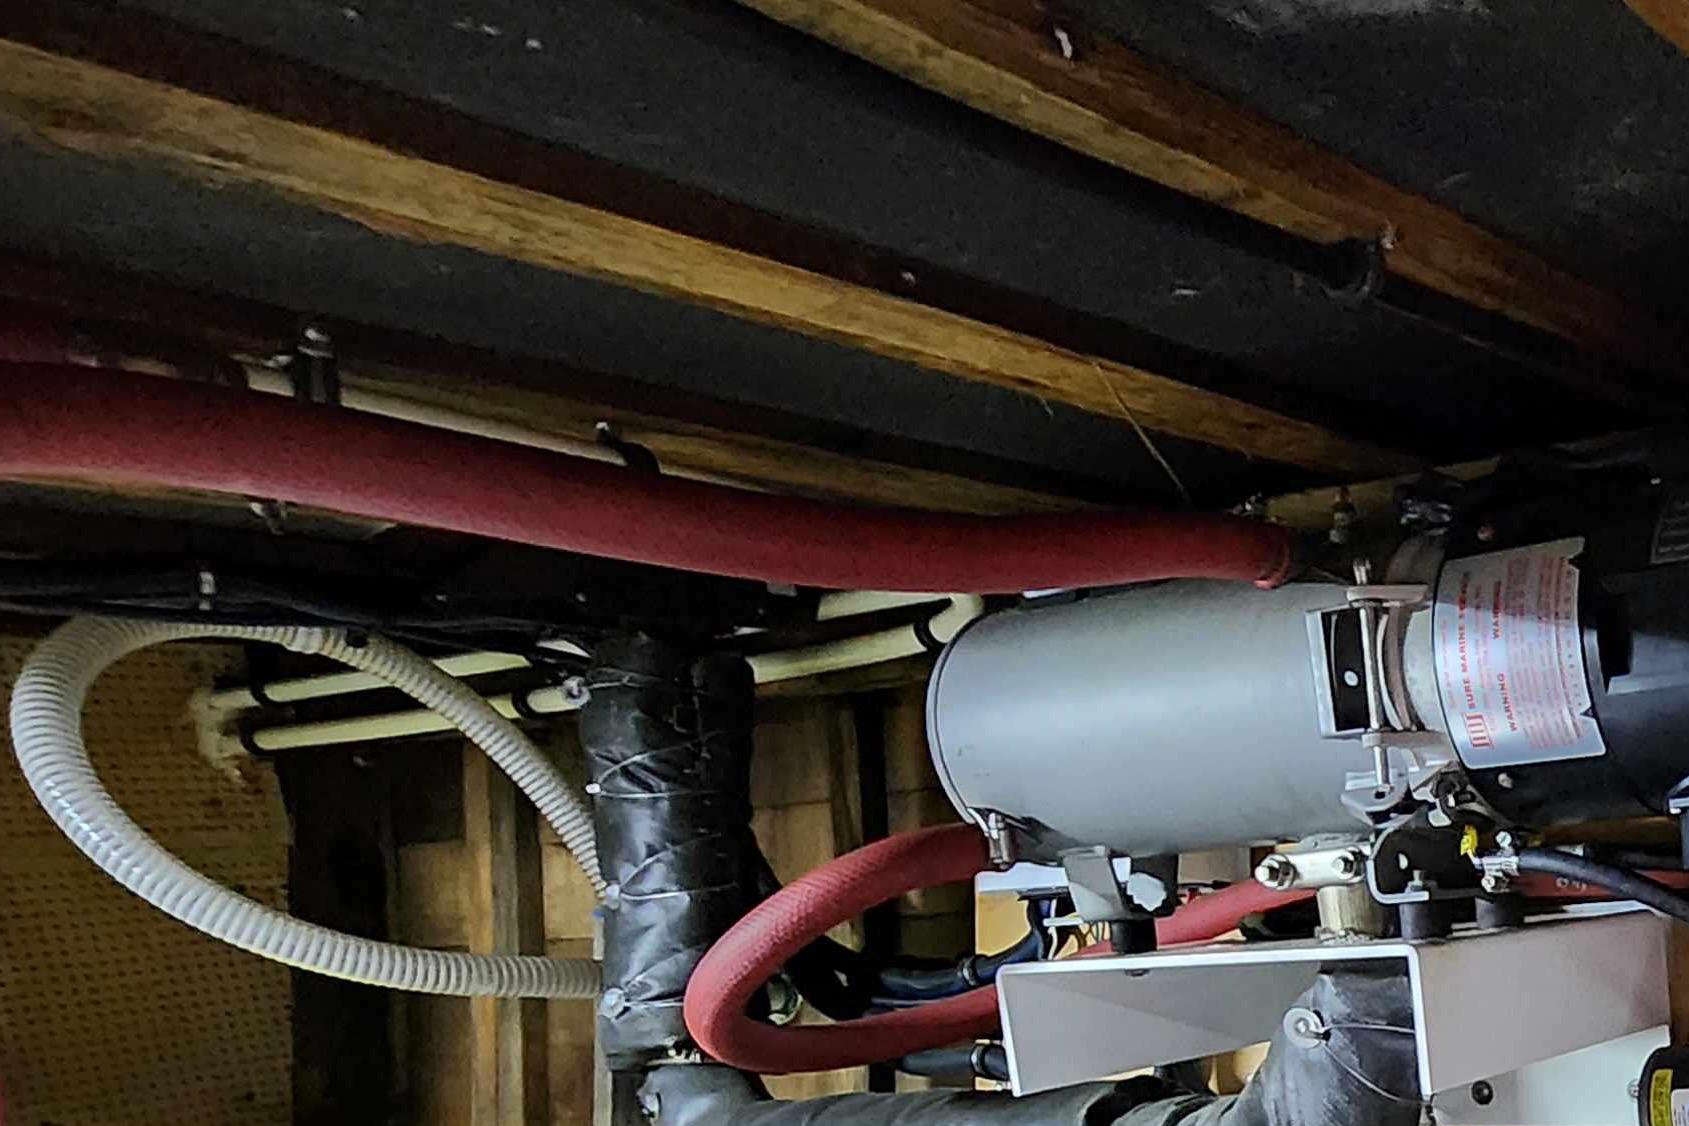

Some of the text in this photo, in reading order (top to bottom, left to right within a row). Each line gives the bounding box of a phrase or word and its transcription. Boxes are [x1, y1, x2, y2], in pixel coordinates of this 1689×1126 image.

[1459, 623, 1471, 674] MARINE
[1464, 678, 1477, 710] SURE
[1497, 672, 1518, 732] WARNING
